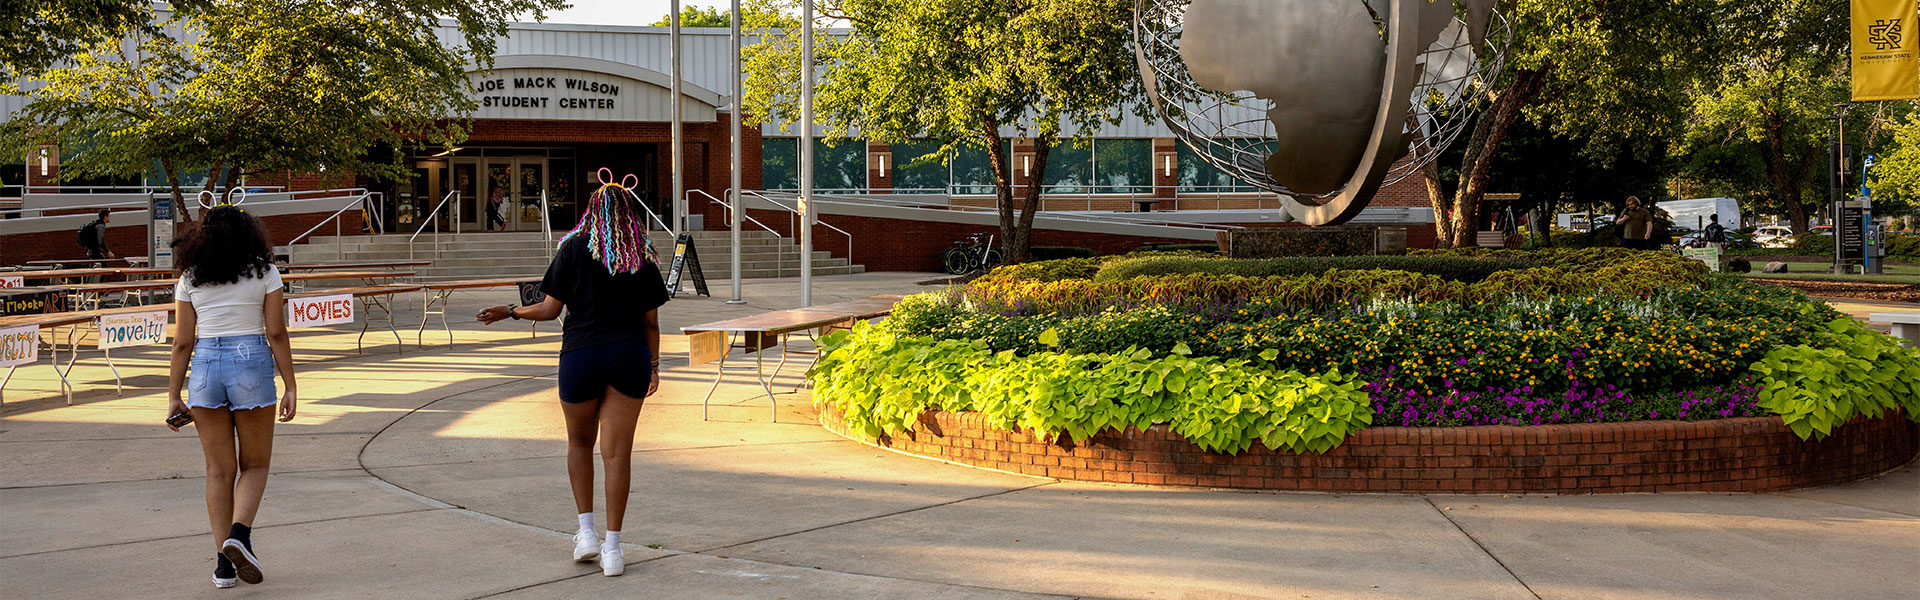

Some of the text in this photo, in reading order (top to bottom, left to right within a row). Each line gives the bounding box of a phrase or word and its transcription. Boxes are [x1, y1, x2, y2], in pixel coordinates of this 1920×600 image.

[477, 77, 619, 96] JOE MACK WILSON
[483, 96, 615, 109] STUDENT CENTER
[43, 292, 67, 313] ART
[293, 299, 351, 322] MOVIES
[105, 317, 163, 344] novelty
